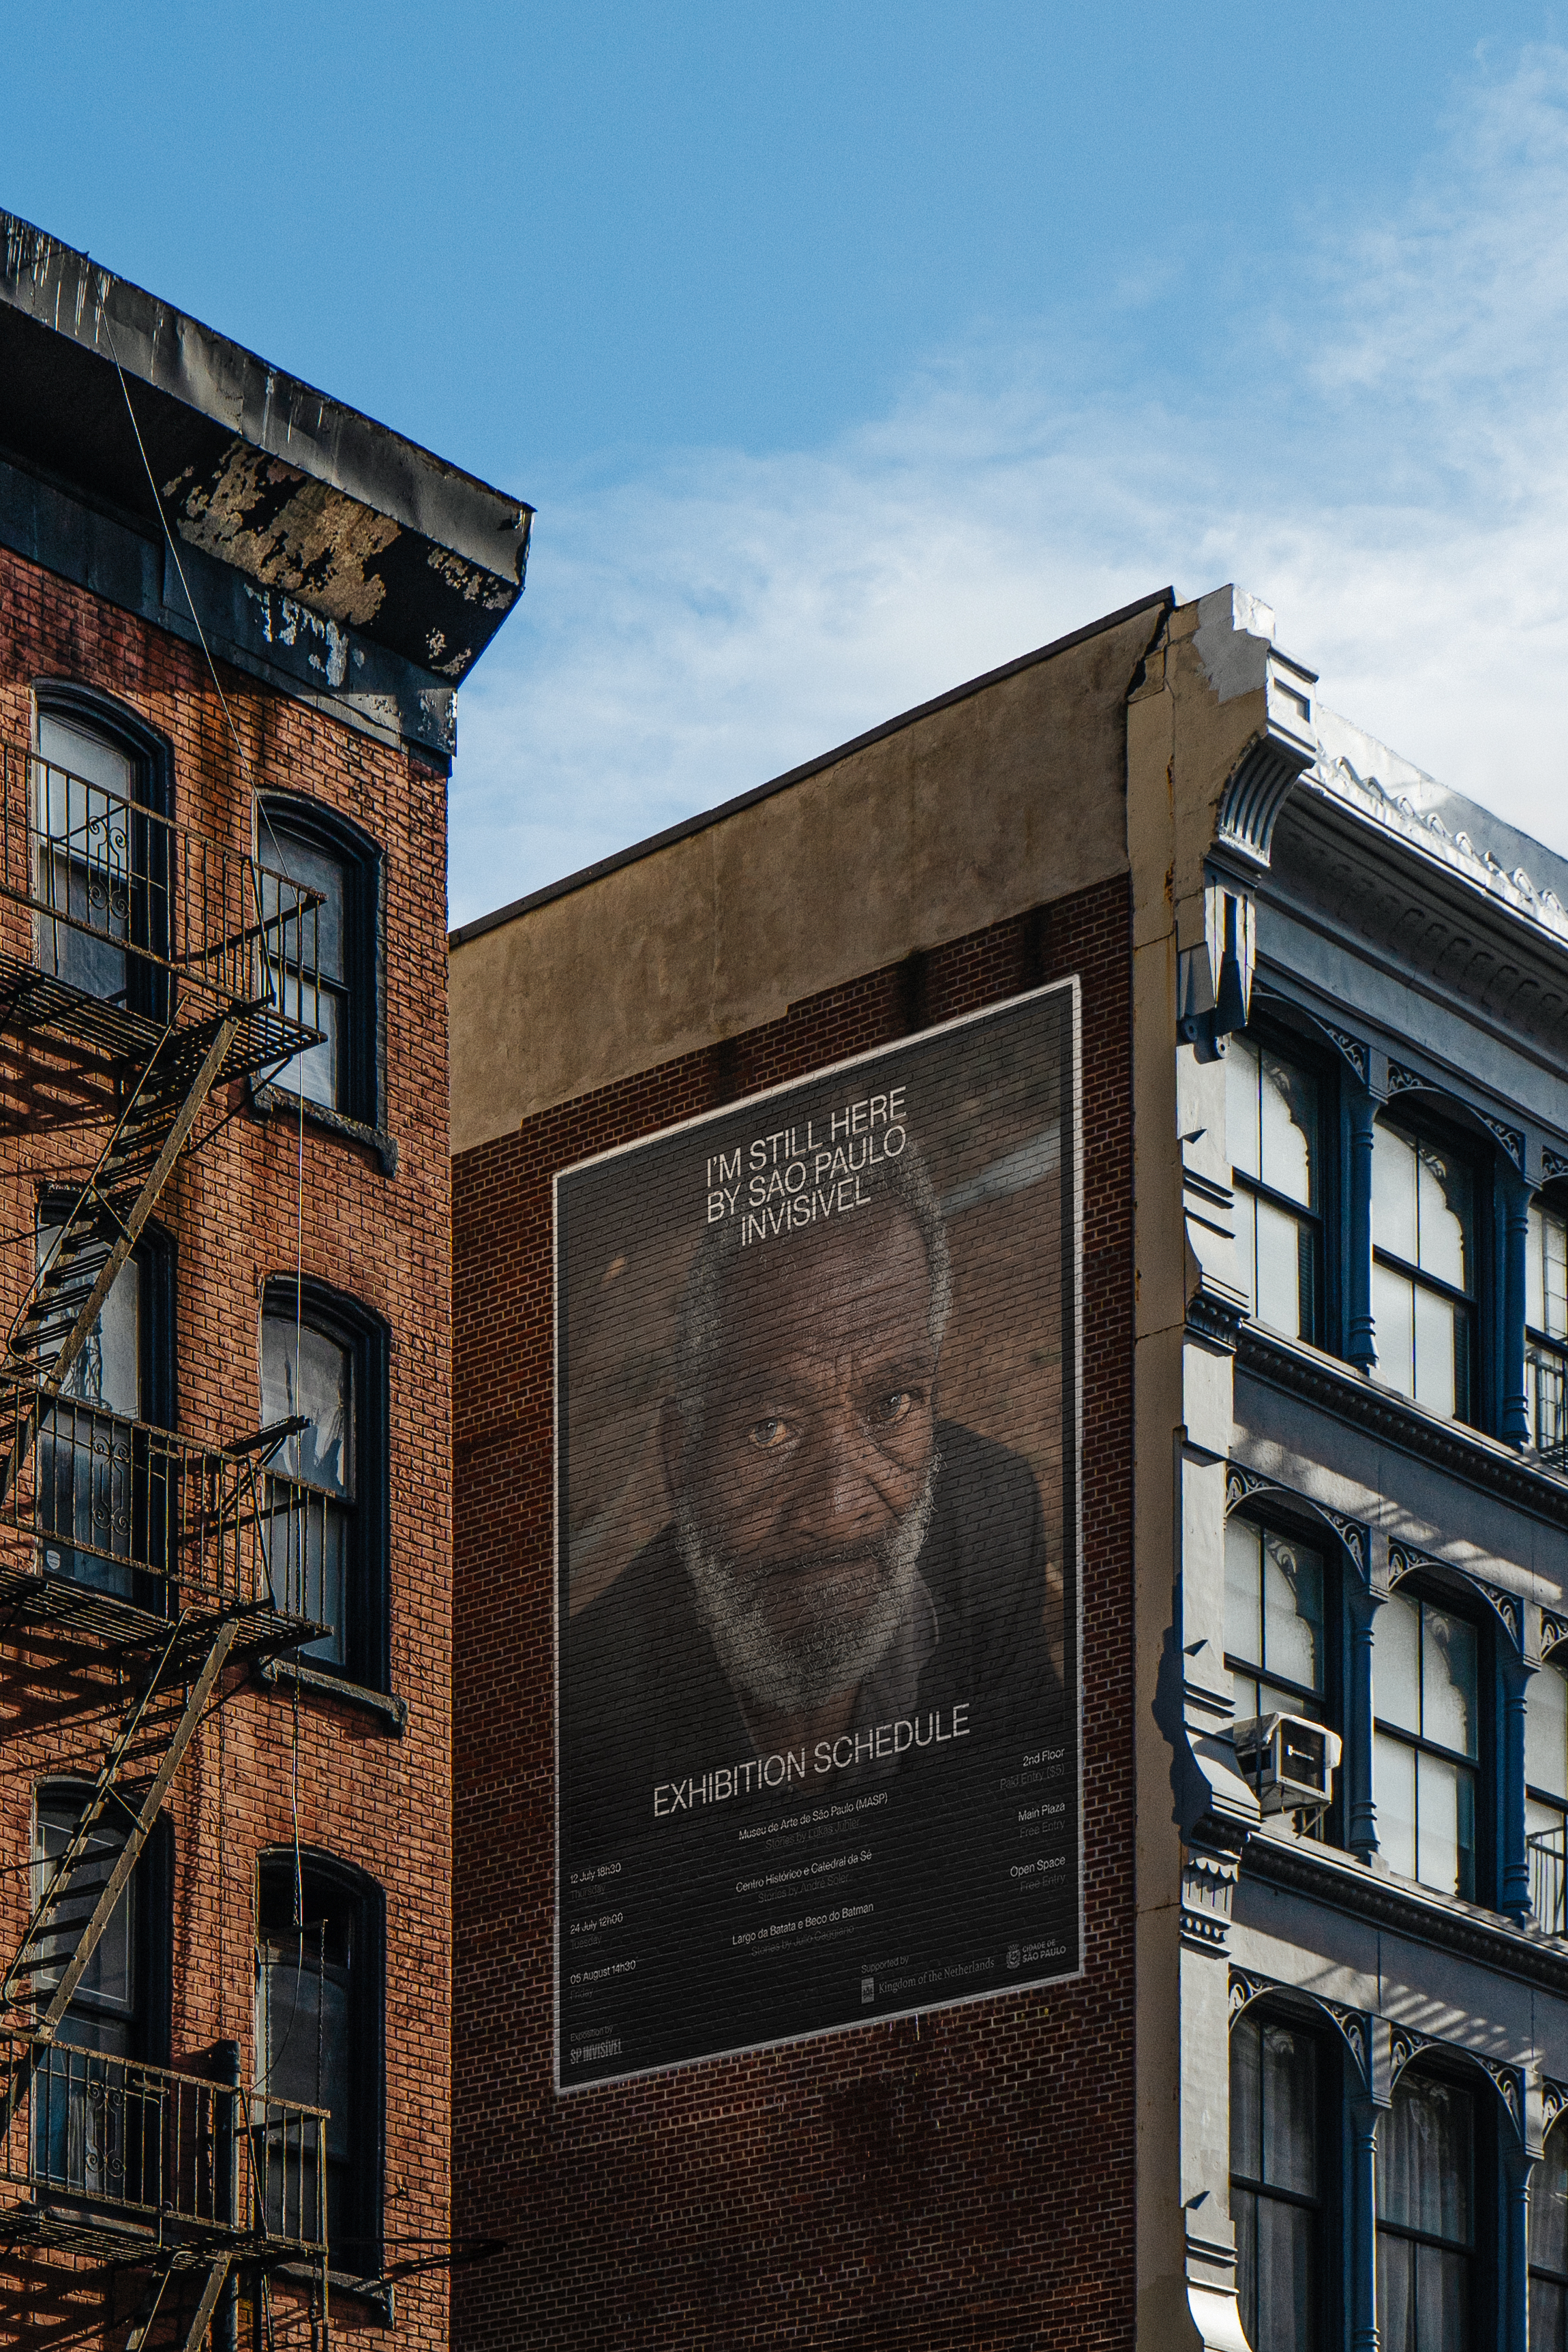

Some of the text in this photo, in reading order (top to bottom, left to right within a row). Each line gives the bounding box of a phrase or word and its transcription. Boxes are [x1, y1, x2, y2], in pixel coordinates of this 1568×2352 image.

[708, 1086, 907, 1187] I'M STILL HERE
[708, 1126, 906, 1223] BY SAO PAULO
[742, 1175, 871, 1246] INVISIVEL
[654, 1703, 970, 1817] EXHIBITION SCHEDULE
[1023, 1748, 1065, 1766] 2nd Floor
[1000, 1764, 1065, 1789] Paid Entry ($5)
[739, 1792, 888, 1840] Museu de Arte de São Paulo (MASP)
[1019, 1803, 1065, 1821] Main Plaza
[766, 1833, 795, 1850] Stories
[797, 1831, 806, 1843] by
[809, 1826, 833, 1839] Lukas
[1020, 1820, 1066, 1838] Free Entry
[571, 1863, 621, 1884] 12 July 18h30
[736, 1849, 872, 1893] Centro Histórico e Catedral da Sé
[1010, 1856, 1066, 1877] Open Space
[758, 1888, 786, 1903] Stories
[788, 1886, 800, 1897] by
[800, 1878, 826, 1892] André
[1020, 1874, 1066, 1892] Free Entry
[571, 1912, 623, 1935] 24 July 12h00
[732, 1903, 874, 1945] Largo da Batata e Beco do Batman
[571, 1935, 602, 1950] Tuesday
[751, 1944, 780, 1957] Stories
[783, 1941, 792, 1951] by
[1022, 1939, 1056, 1953] CIDADE DE
[1040, 1946, 1066, 1959] PAULO
[571, 1959, 636, 1985] 05 August 14h30
[861, 1955, 909, 1974] Supported by
[879, 1957, 995, 1994] Kingdom of the Netherlands
[570, 1987, 594, 2000] Friday
[571, 2026, 613, 2042] Exposition by
[571, 2047, 582, 2064] SP
